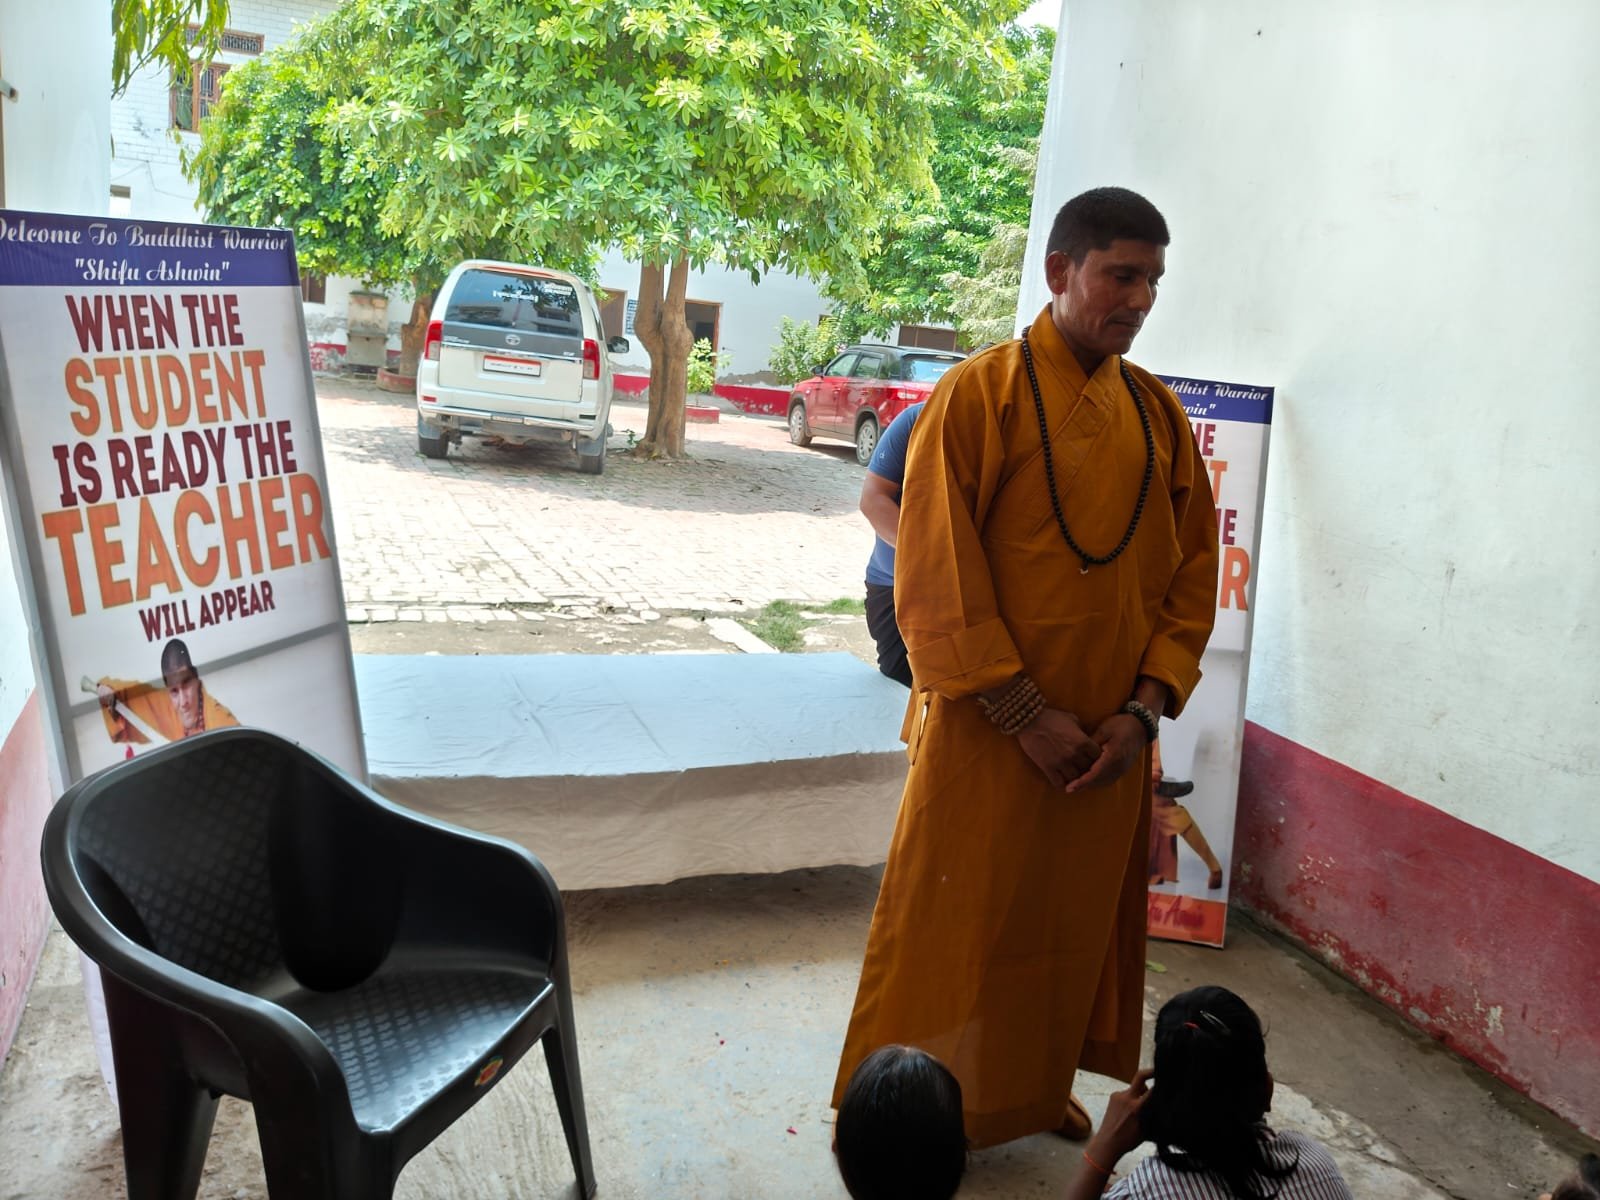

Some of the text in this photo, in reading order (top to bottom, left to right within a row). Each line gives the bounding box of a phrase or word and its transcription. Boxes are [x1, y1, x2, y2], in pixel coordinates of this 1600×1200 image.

[88, 223, 118, 246] To
[124, 224, 215, 249] Buddhist
[220, 229, 288, 251] Warrior
[75, 258, 231, 285] "Shifu Ashwin"
[64, 294, 244, 353] WHEN THE
[64, 350, 266, 437] STUDENT
[1167, 380, 1268, 401] ddhist Warrior
[52, 420, 298, 508] IS READY THE
[41, 472, 332, 617] TEACHER
[139, 580, 276, 642] WILL APPEAR
